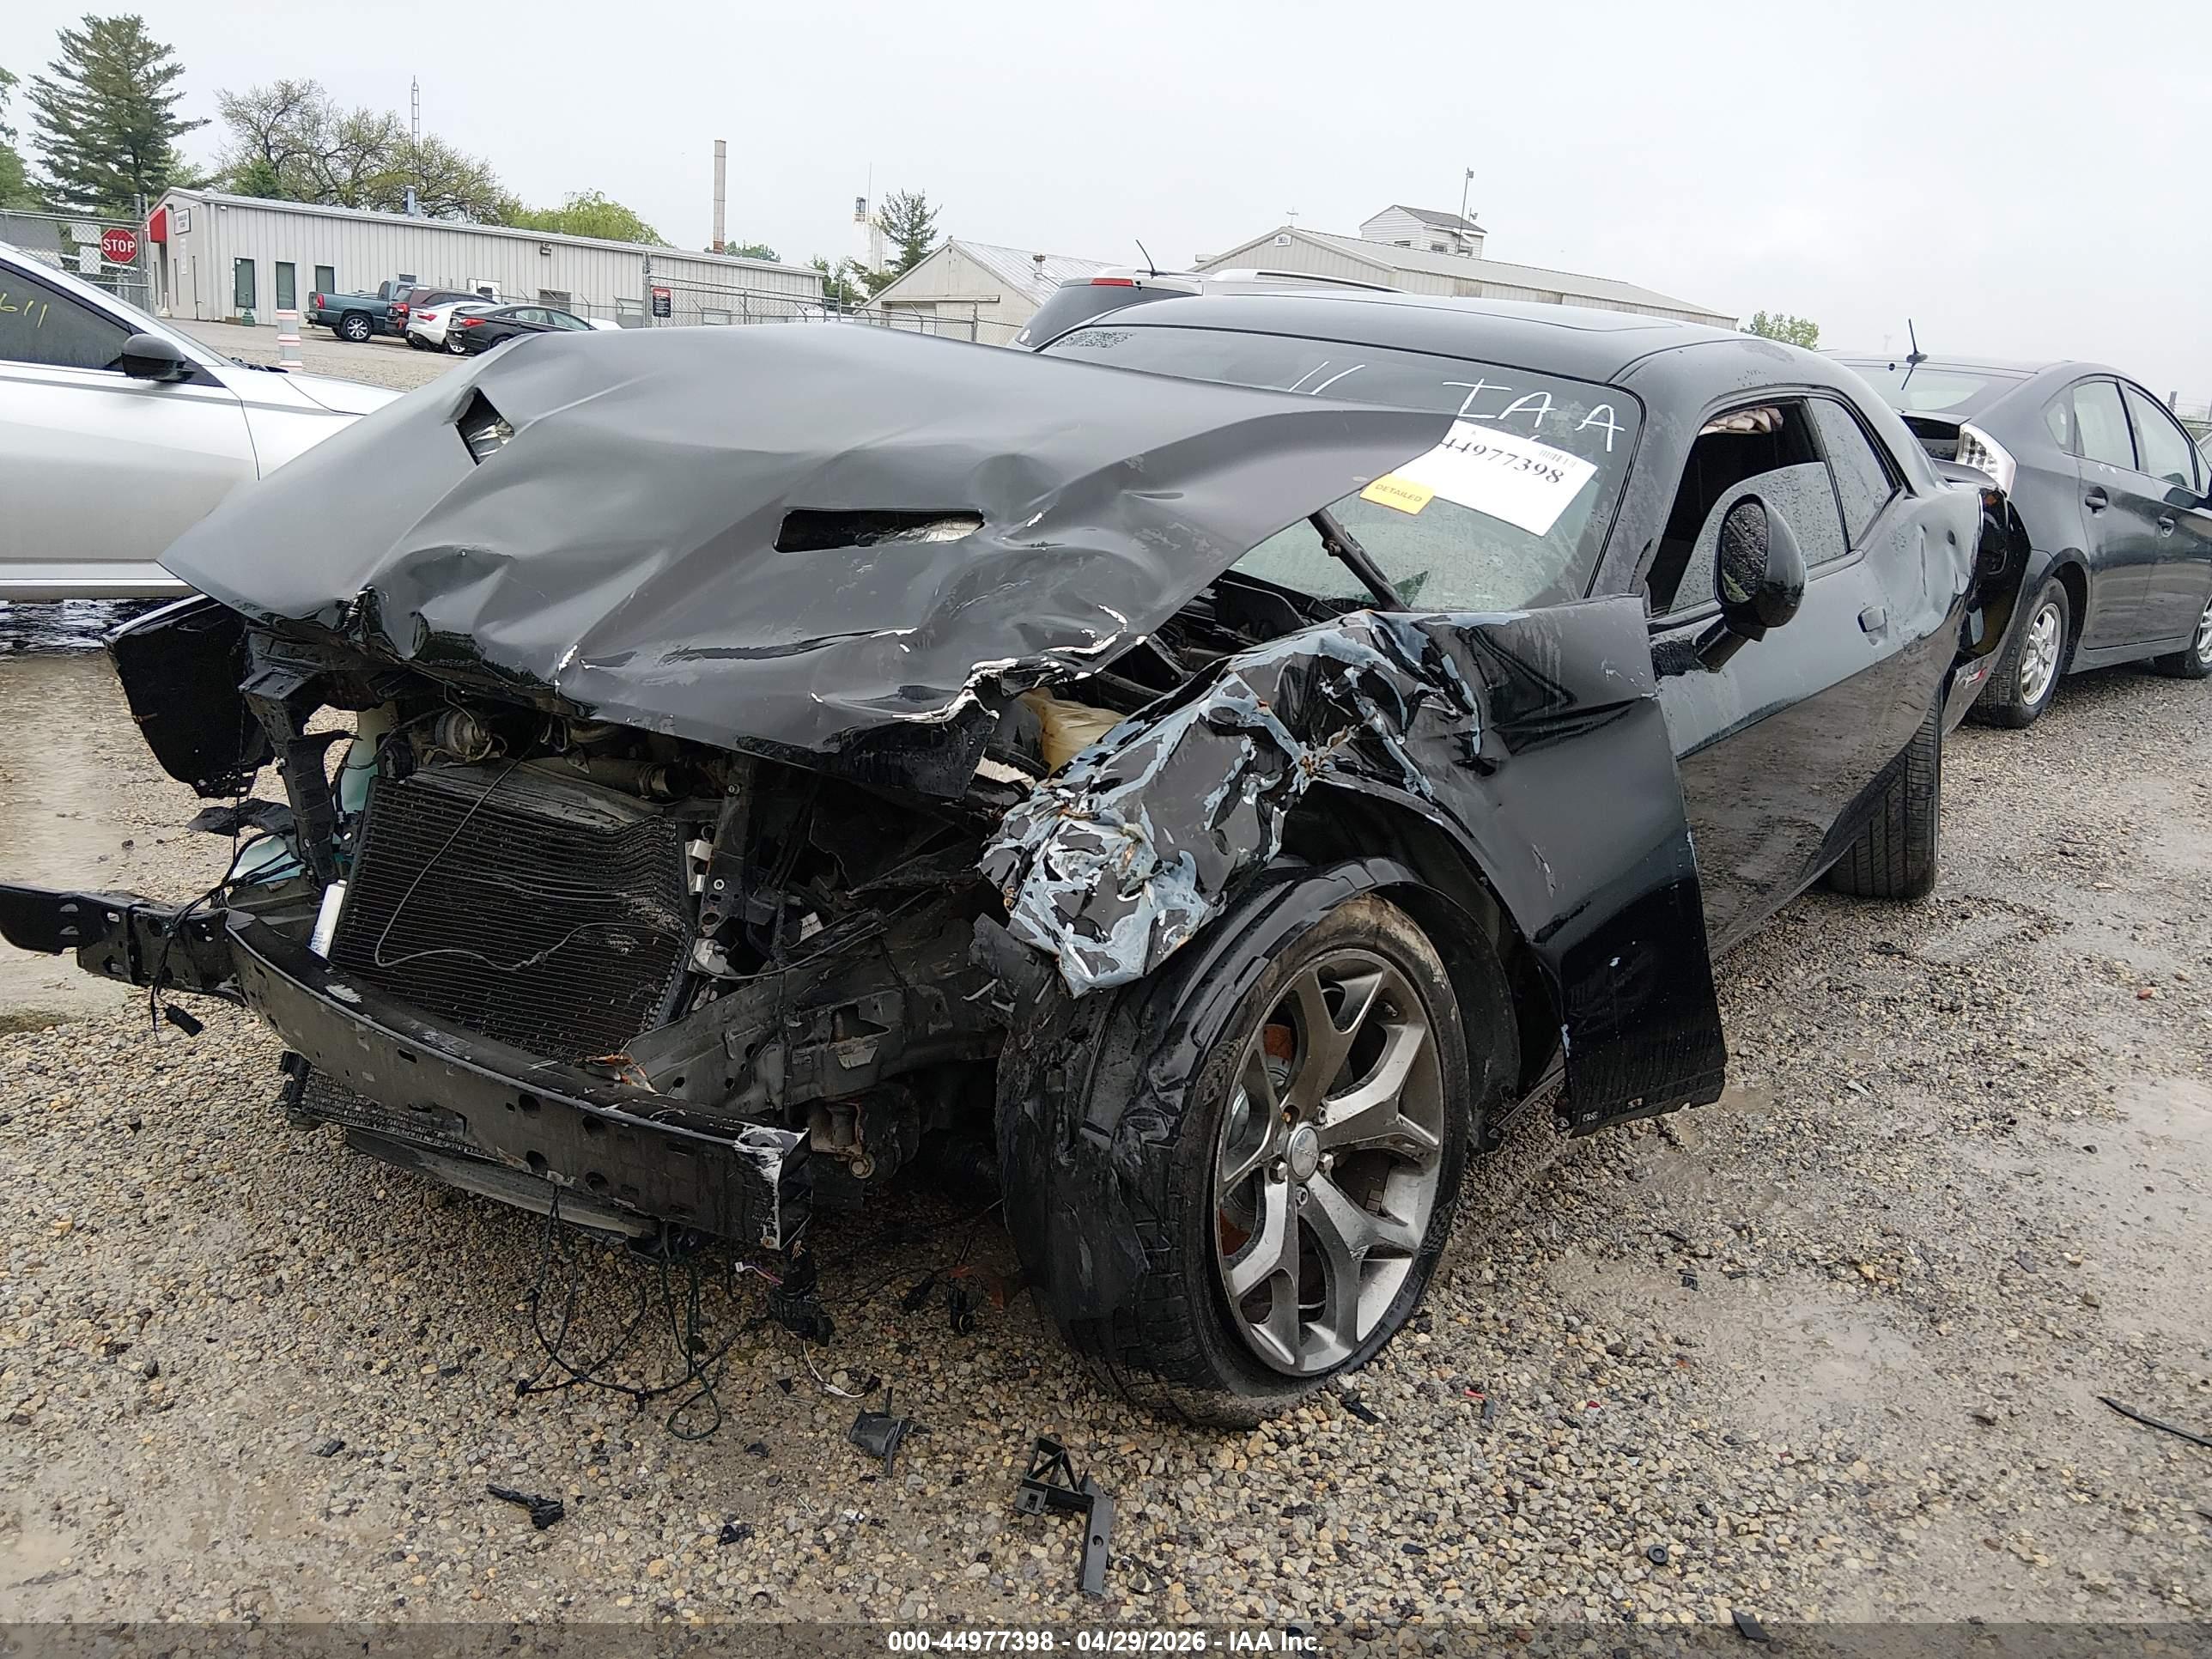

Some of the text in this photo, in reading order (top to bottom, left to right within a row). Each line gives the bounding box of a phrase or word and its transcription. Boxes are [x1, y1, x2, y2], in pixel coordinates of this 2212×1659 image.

[103, 239, 135, 252] STOP
[1441, 438, 1564, 483] 44977398
[1375, 483, 1422, 501] DETAILED
